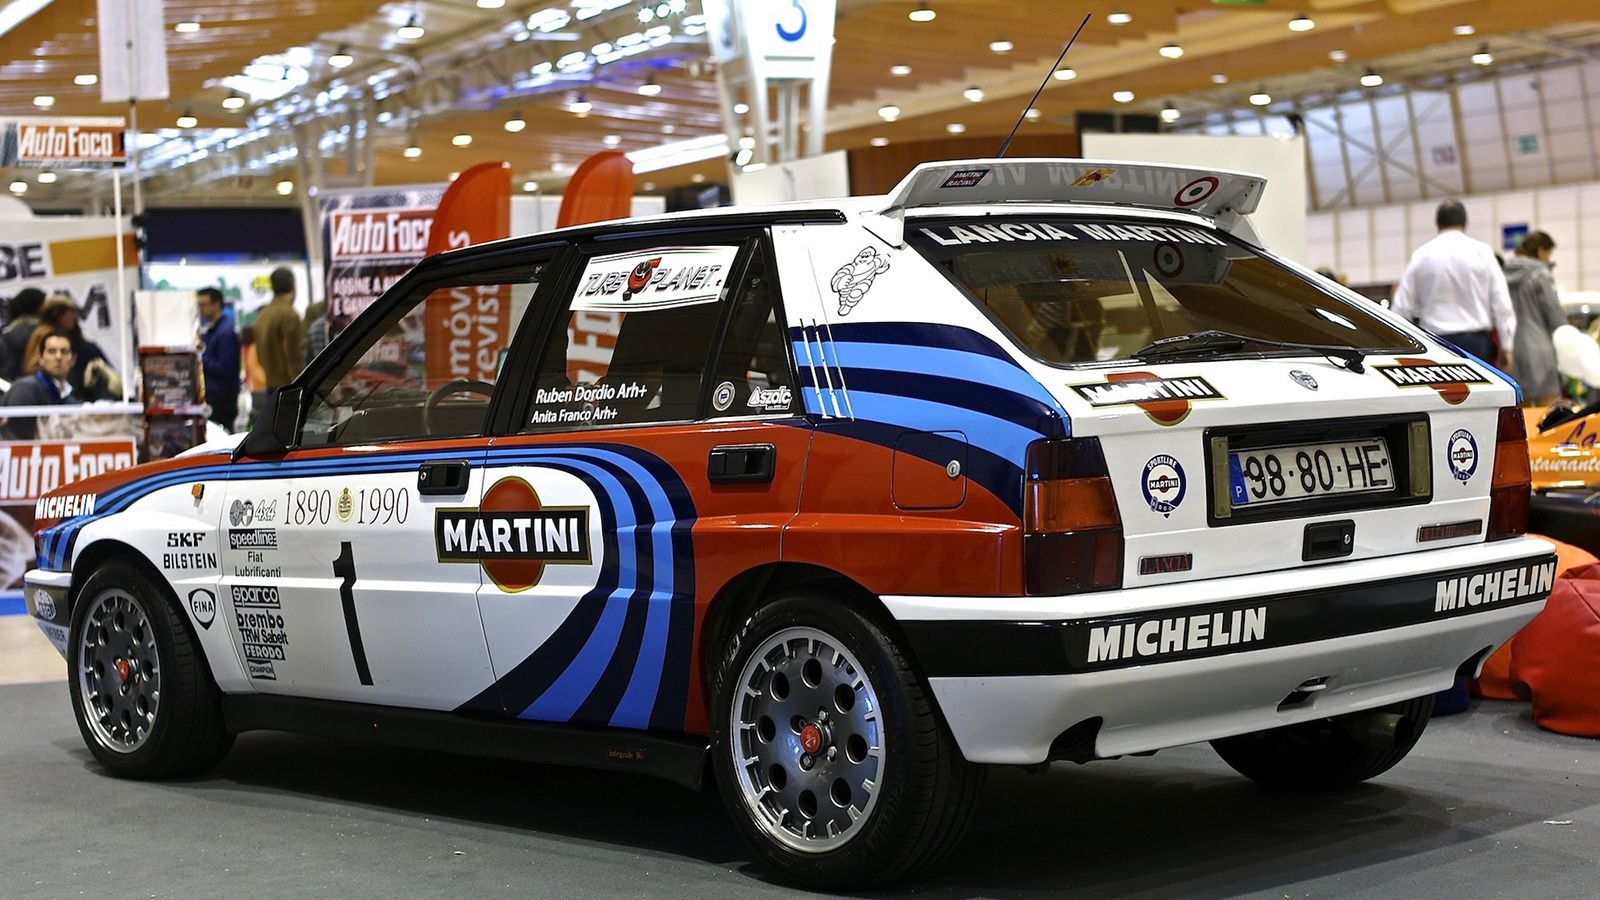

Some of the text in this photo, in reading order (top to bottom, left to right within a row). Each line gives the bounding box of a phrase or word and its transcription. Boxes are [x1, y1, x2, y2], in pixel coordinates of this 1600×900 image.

[919, 223, 1228, 248] LANCIA MARTINI
[1383, 365, 1482, 385] MARTINI
[535, 381, 648, 404] Ruben Dordio Arh+
[1080, 379, 1214, 405] MTINI
[531, 405, 618, 424] Anita Franco Arh+
[1147, 456, 1177, 470] SPORTLINE
[1149, 478, 1178, 490] MARTINI
[1235, 485, 1243, 498] P
[35, 493, 97, 519] MICHELIN
[255, 499, 277, 521] 4x4
[284, 487, 409, 525] 1890 1990
[167, 532, 206, 547] SKF
[443, 517, 580, 553] MARTINI
[163, 553, 217, 569] BILSTEIN
[247, 551, 263, 563] Fiat
[234, 566, 281, 578] Lubrificanti
[1434, 562, 1555, 612] MICHELIN
[193, 600, 213, 613] FINA
[232, 588, 279, 607] sparco
[235, 609, 284, 629] brembo
[332, 541, 374, 686] 1
[239, 628, 289, 645] TRW Sabelt
[1087, 606, 1267, 663] MICHELIN
[246, 645, 282, 659] FERODO
